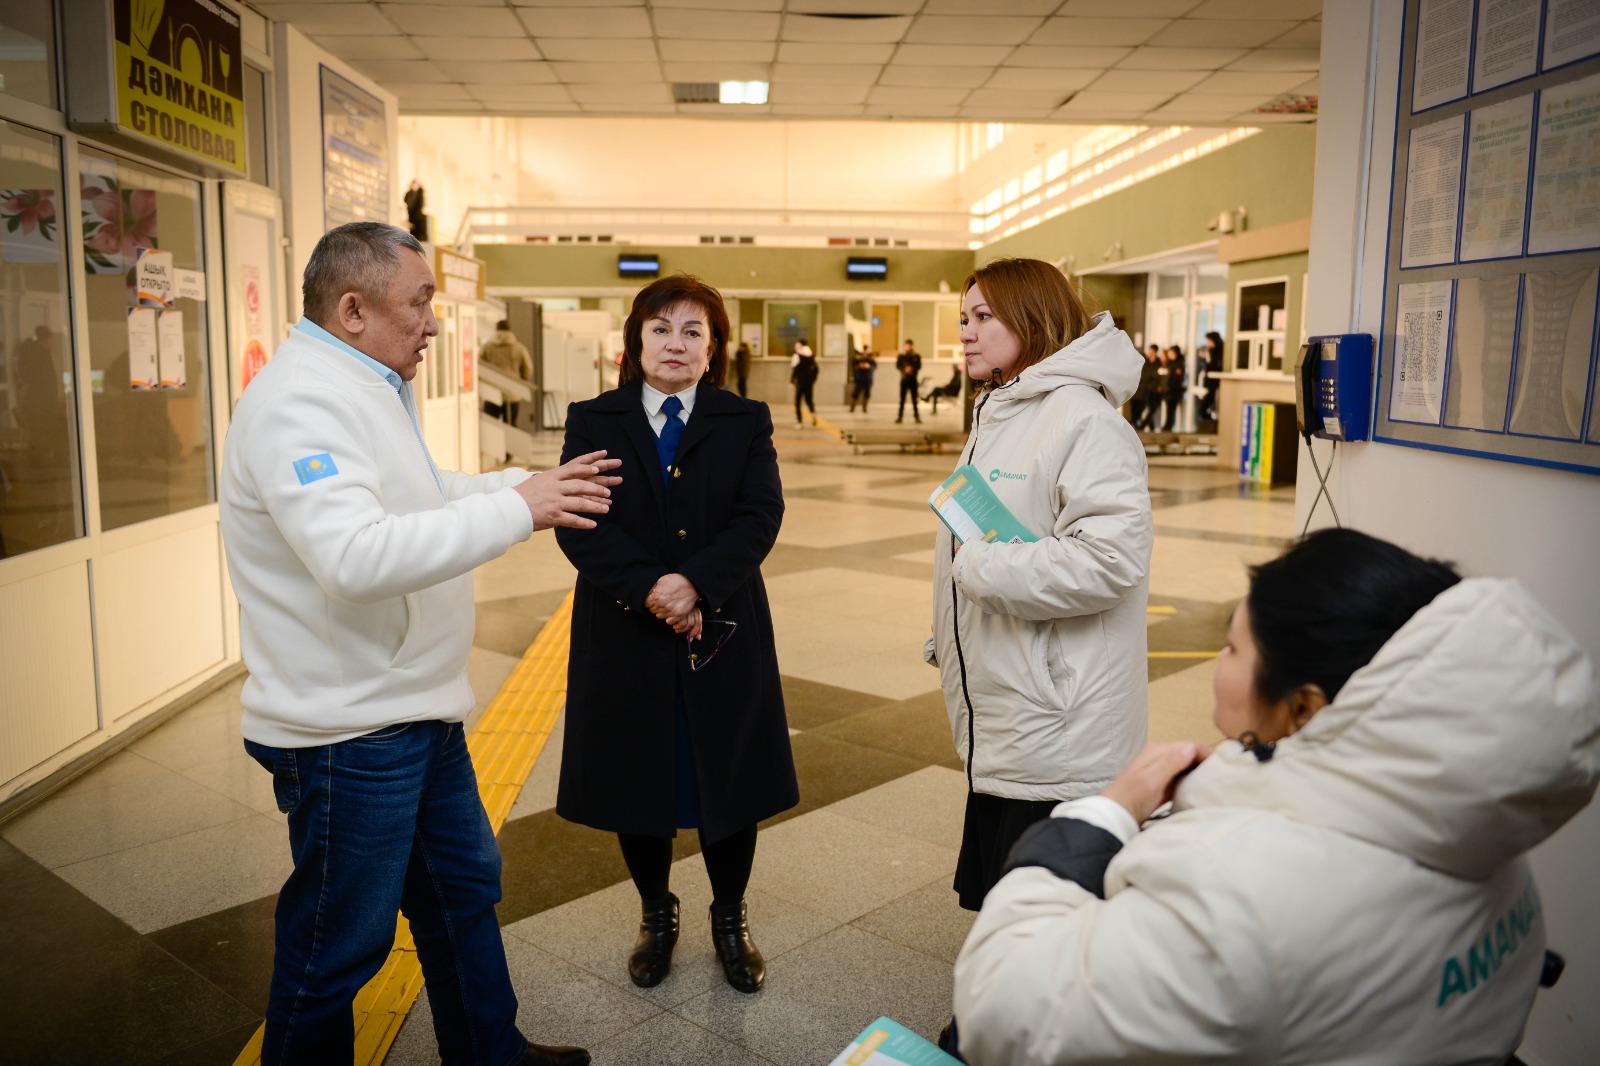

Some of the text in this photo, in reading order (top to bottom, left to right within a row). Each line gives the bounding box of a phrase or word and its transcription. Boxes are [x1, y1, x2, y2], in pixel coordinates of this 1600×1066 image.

[128, 56, 236, 129] ДӘМХАНА
[130, 100, 237, 165] СТОЛОВАЯ
[144, 263, 166, 277] АШЫҚ
[141, 278, 170, 291] ОТКРЫТО
[999, 472, 1028, 481] AMANAT
